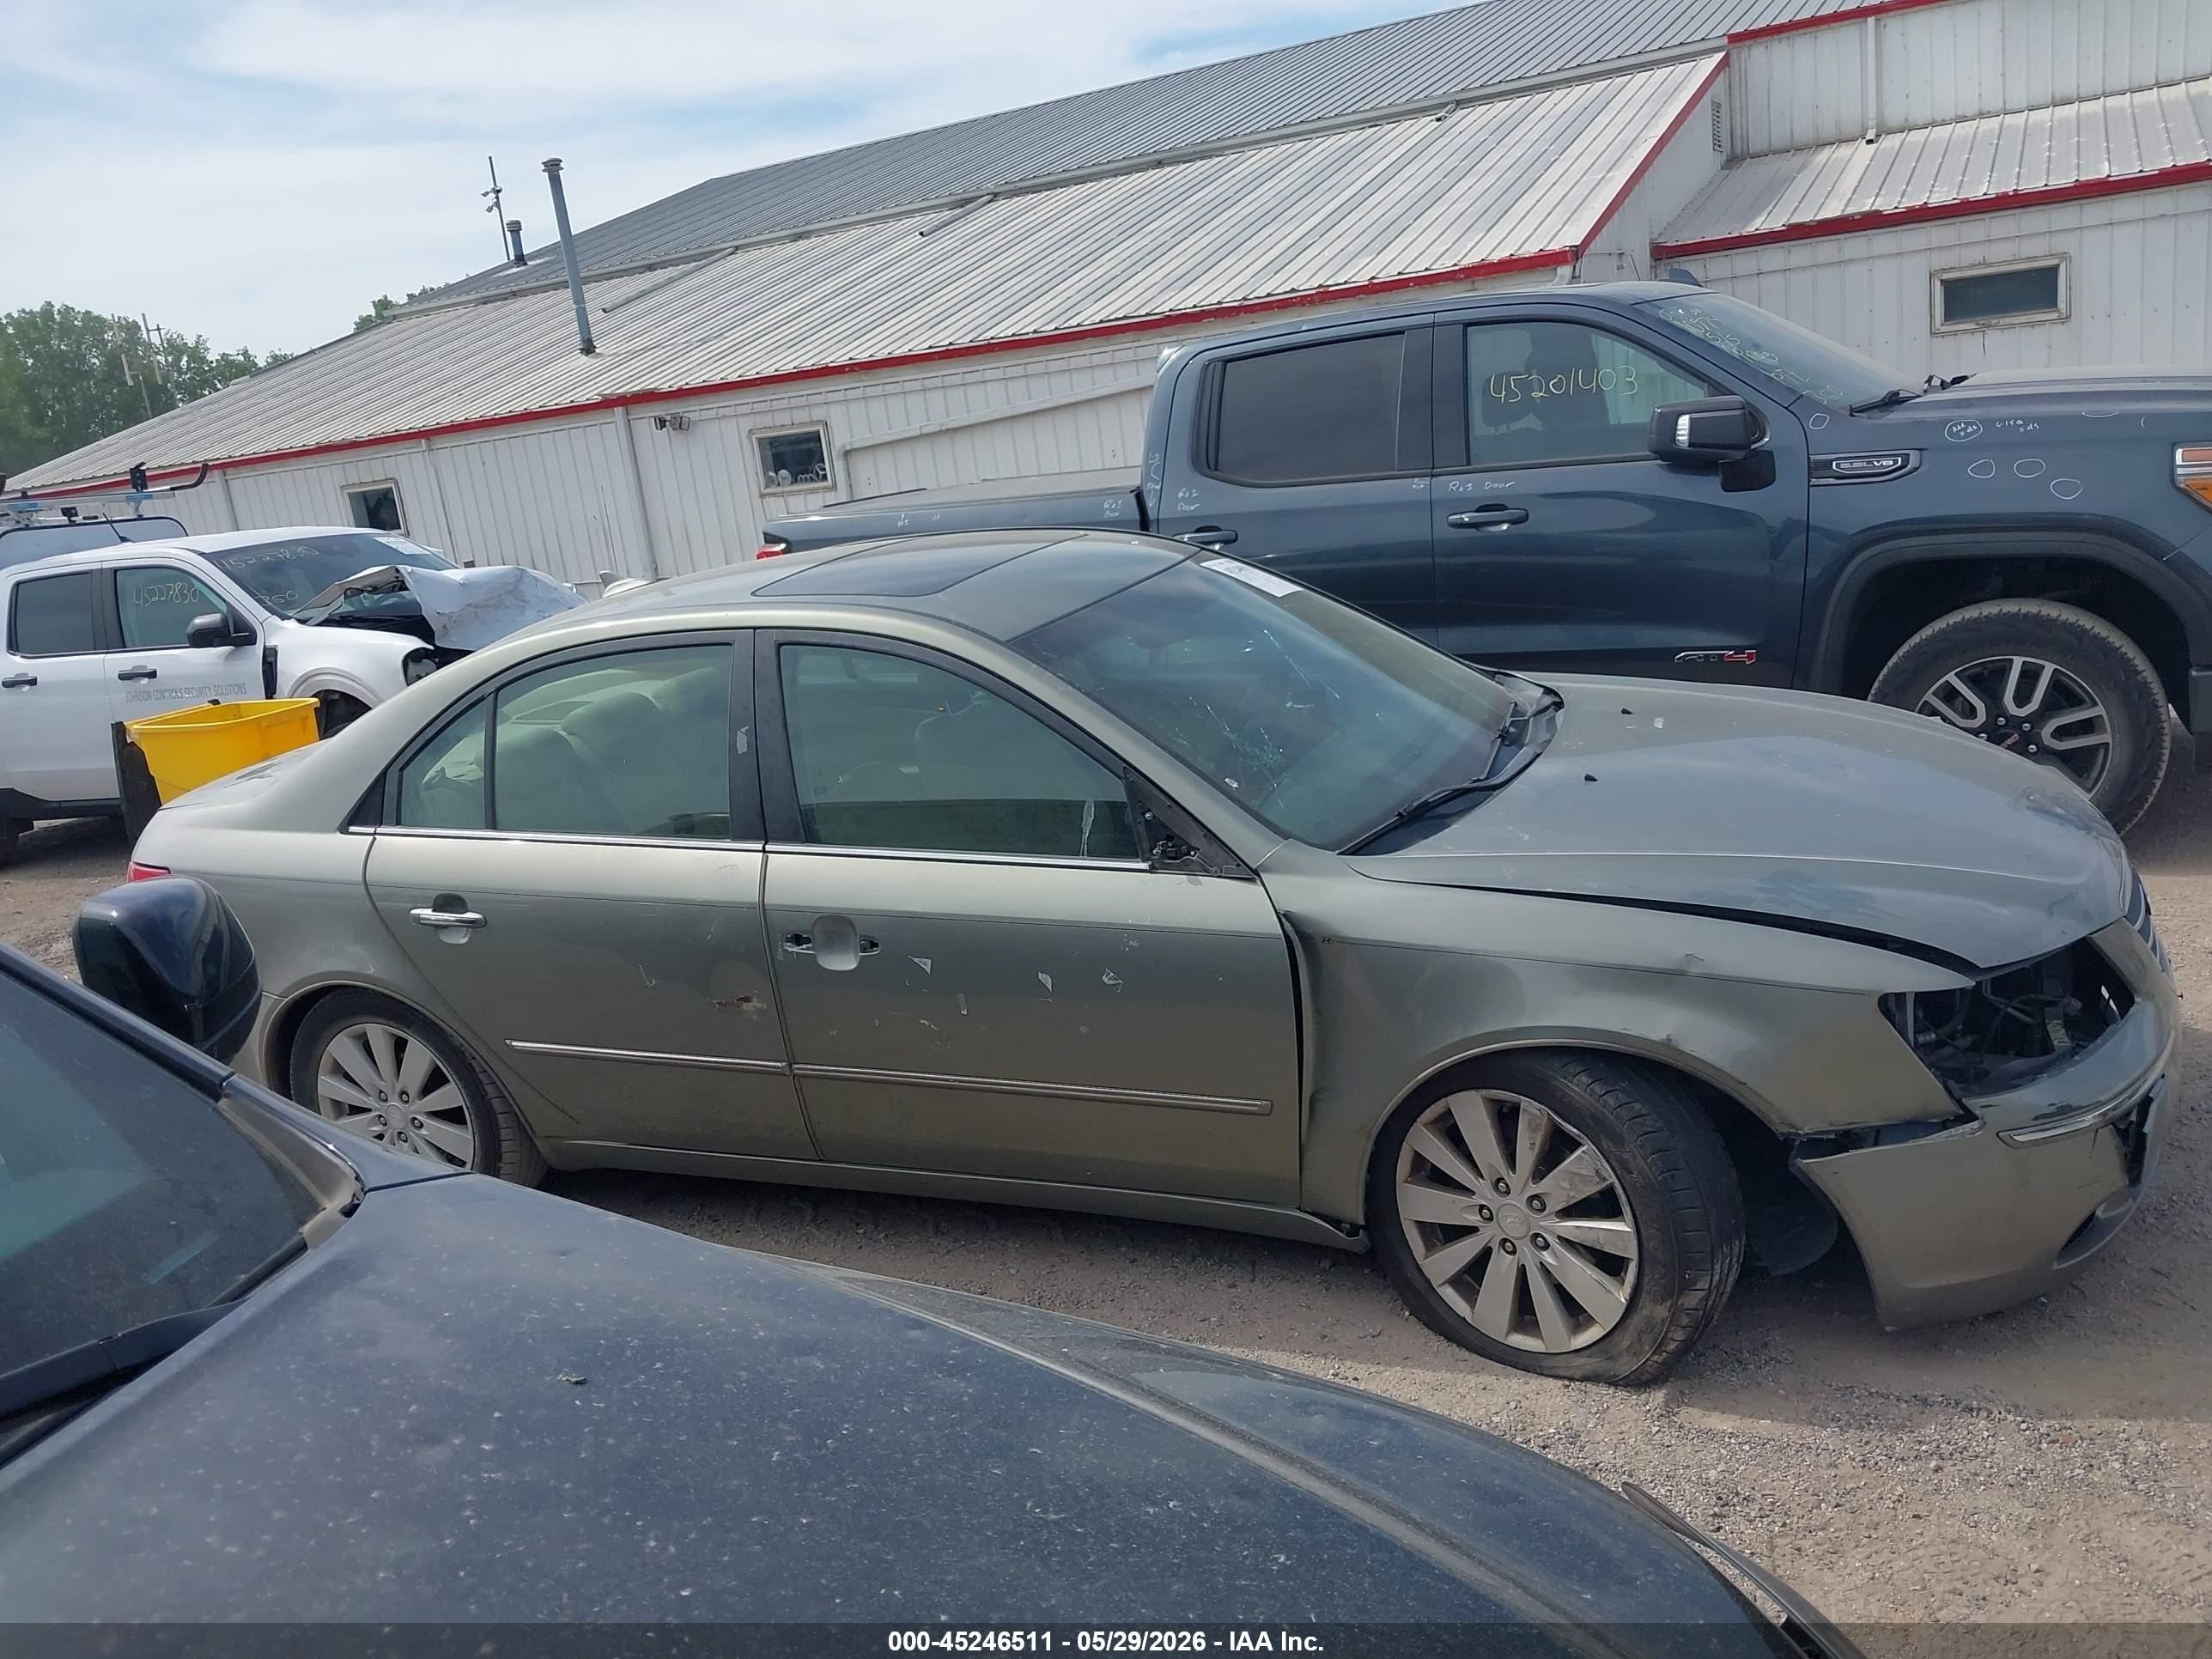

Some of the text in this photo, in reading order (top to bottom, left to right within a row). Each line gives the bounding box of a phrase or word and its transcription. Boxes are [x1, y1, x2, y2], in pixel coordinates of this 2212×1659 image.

[1491, 365, 1638, 404] 45201403
[133, 582, 199, 606] 45227830
[1674, 649, 1757, 665] AT4
[125, 682, 247, 702] JOHNSON CONTROLS SECURITY SOLUTIONS
